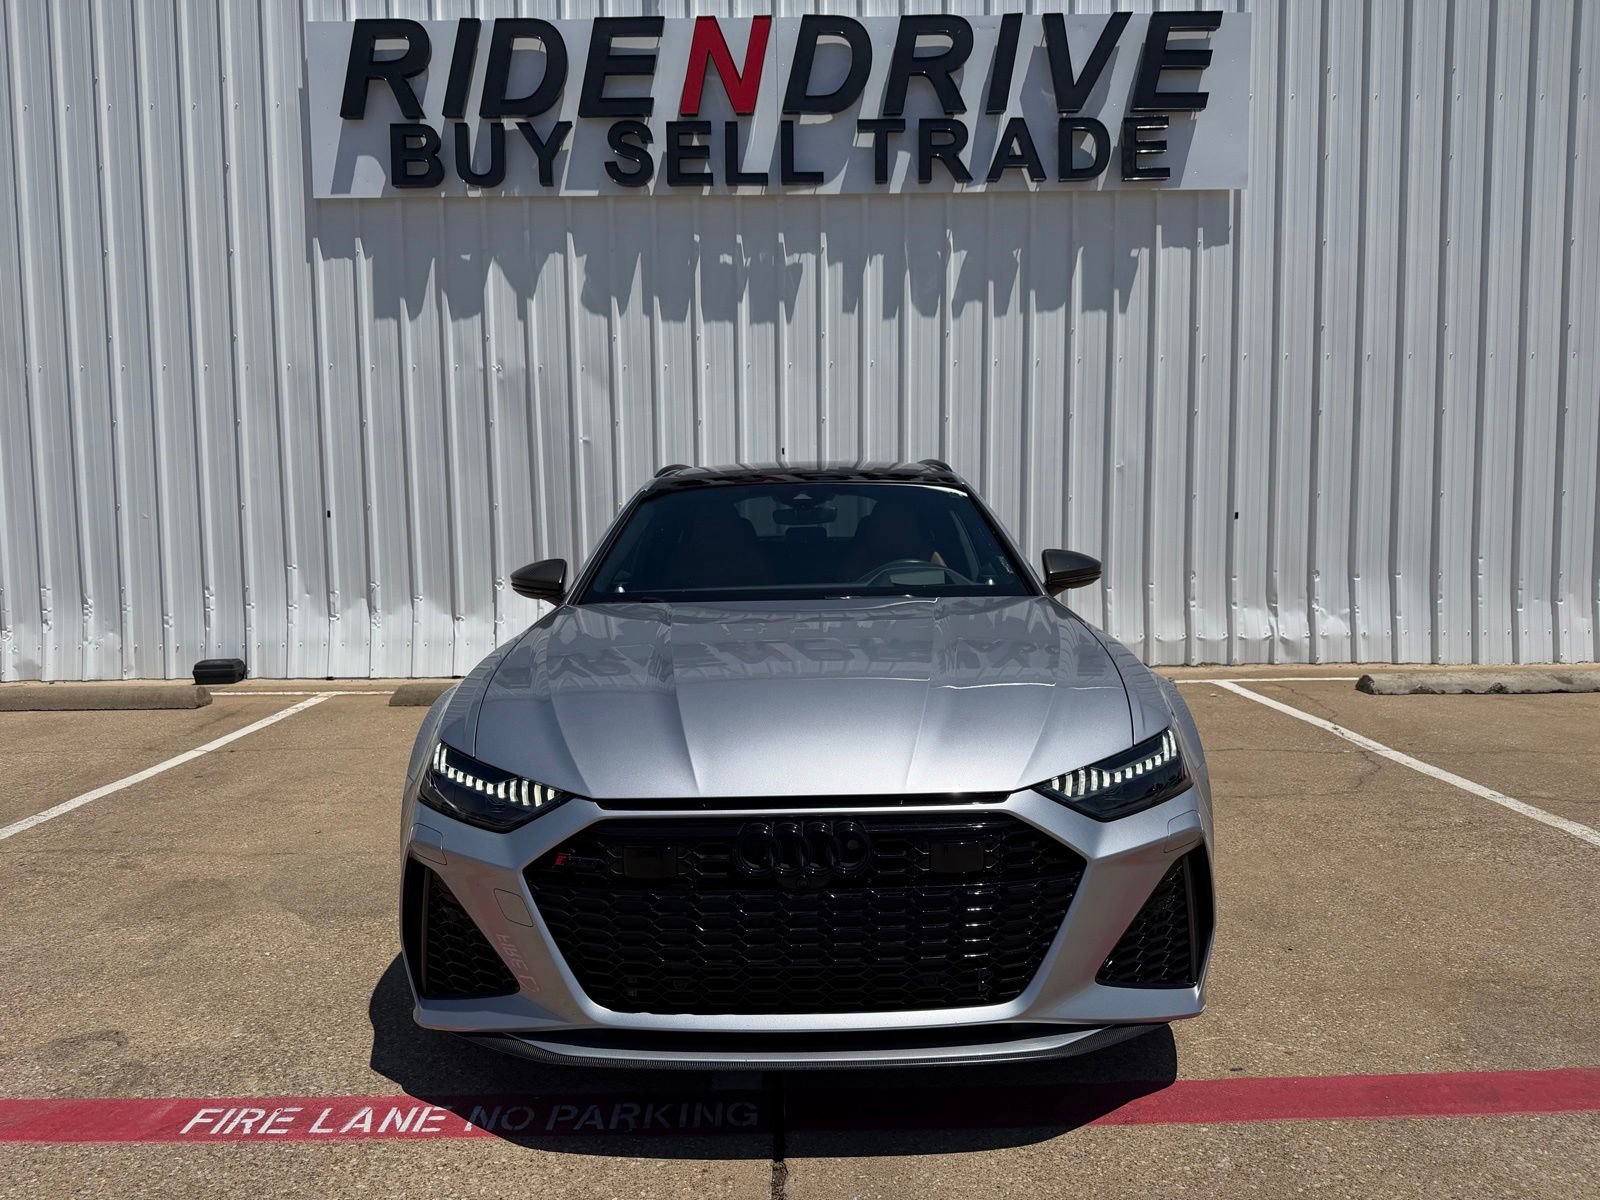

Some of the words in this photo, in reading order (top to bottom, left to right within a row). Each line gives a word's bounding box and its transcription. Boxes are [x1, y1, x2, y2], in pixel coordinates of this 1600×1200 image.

[340, 11, 1223, 119] RIDENDRIVE
[390, 121, 572, 188] BUY
[604, 120, 824, 187] SELL
[857, 116, 1171, 184] TRADE
[179, 1107, 303, 1135] FIRE
[309, 1106, 447, 1135] LANE
[464, 1104, 536, 1132] NO
[545, 1101, 760, 1131] PARKING
